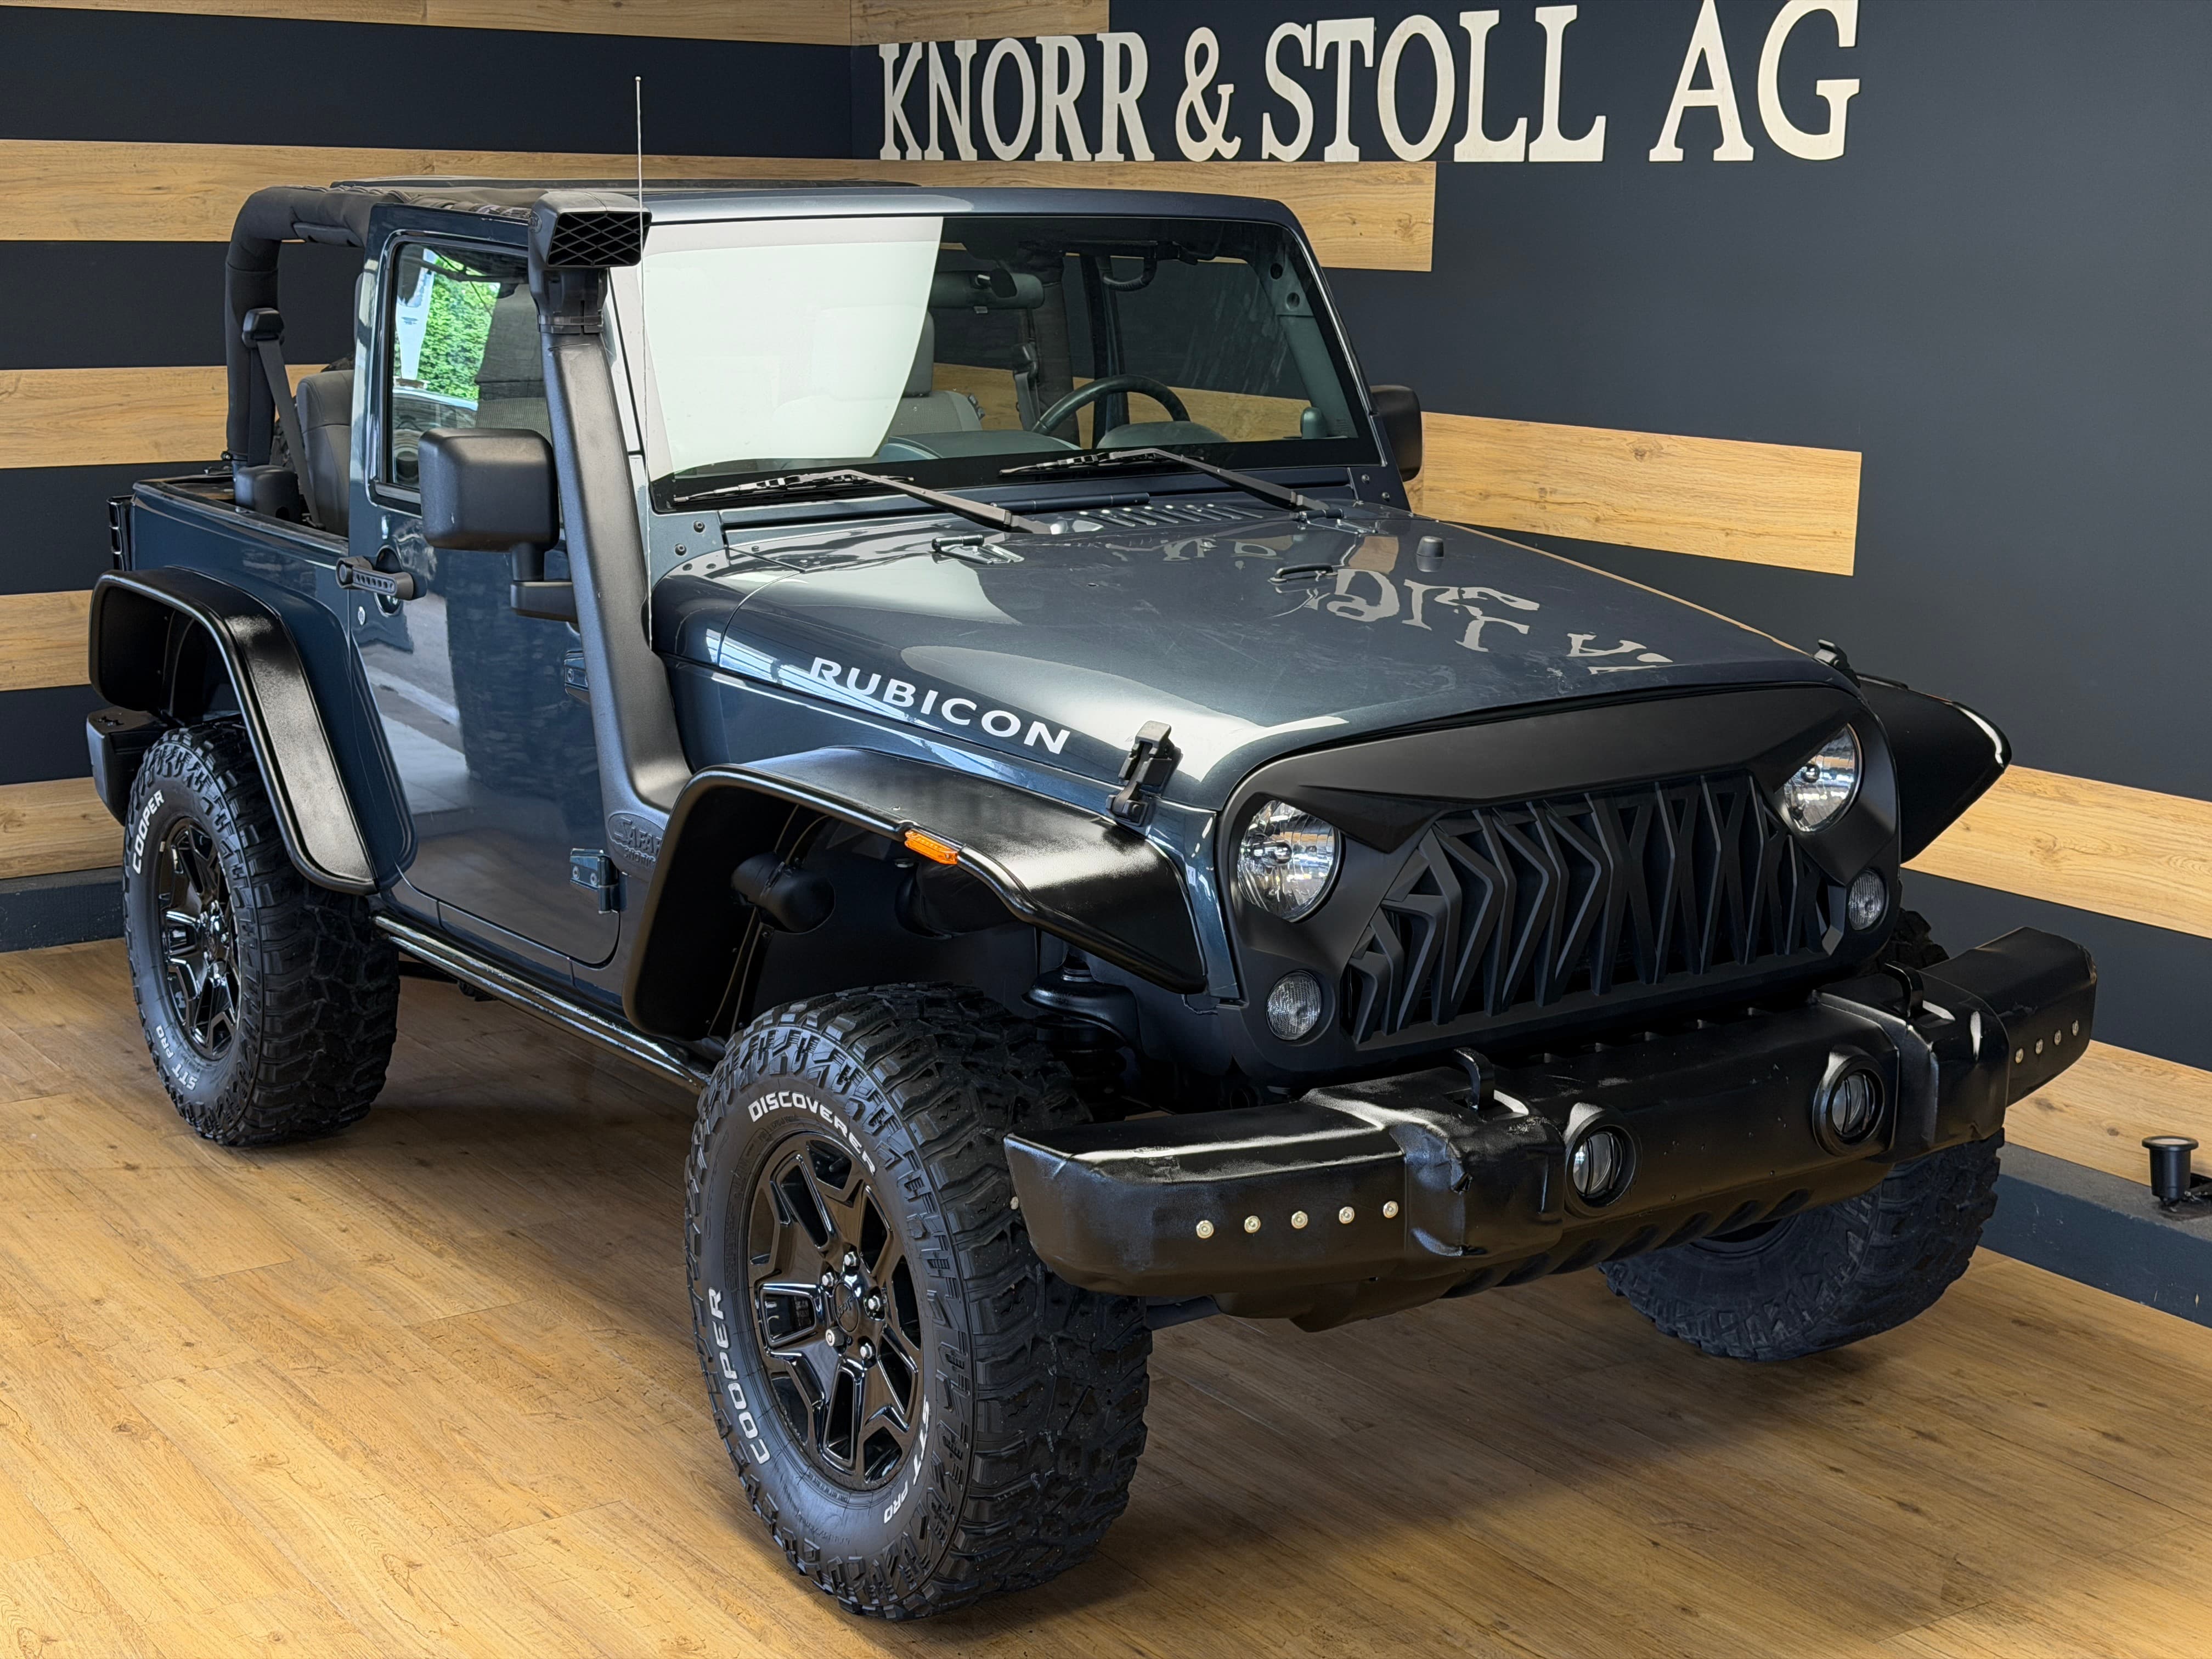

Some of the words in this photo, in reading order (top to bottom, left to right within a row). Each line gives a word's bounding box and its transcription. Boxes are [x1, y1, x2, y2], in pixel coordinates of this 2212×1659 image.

[879, 32, 1155, 161] KNORR
[1175, 27, 1242, 162] &
[1261, 4, 1607, 163] STOLL
[1649, 0, 1860, 162] AG
[809, 657, 1071, 755] RUBICON
[132, 789, 165, 874] COOPER
[156, 1024, 175, 1059] PRO
[171, 1063, 198, 1091] STT
[748, 1091, 876, 1175] DISCOVERER
[708, 1288, 770, 1464] COOPER
[913, 1394, 930, 1486] STT
[883, 1480, 909, 1524] PRO
